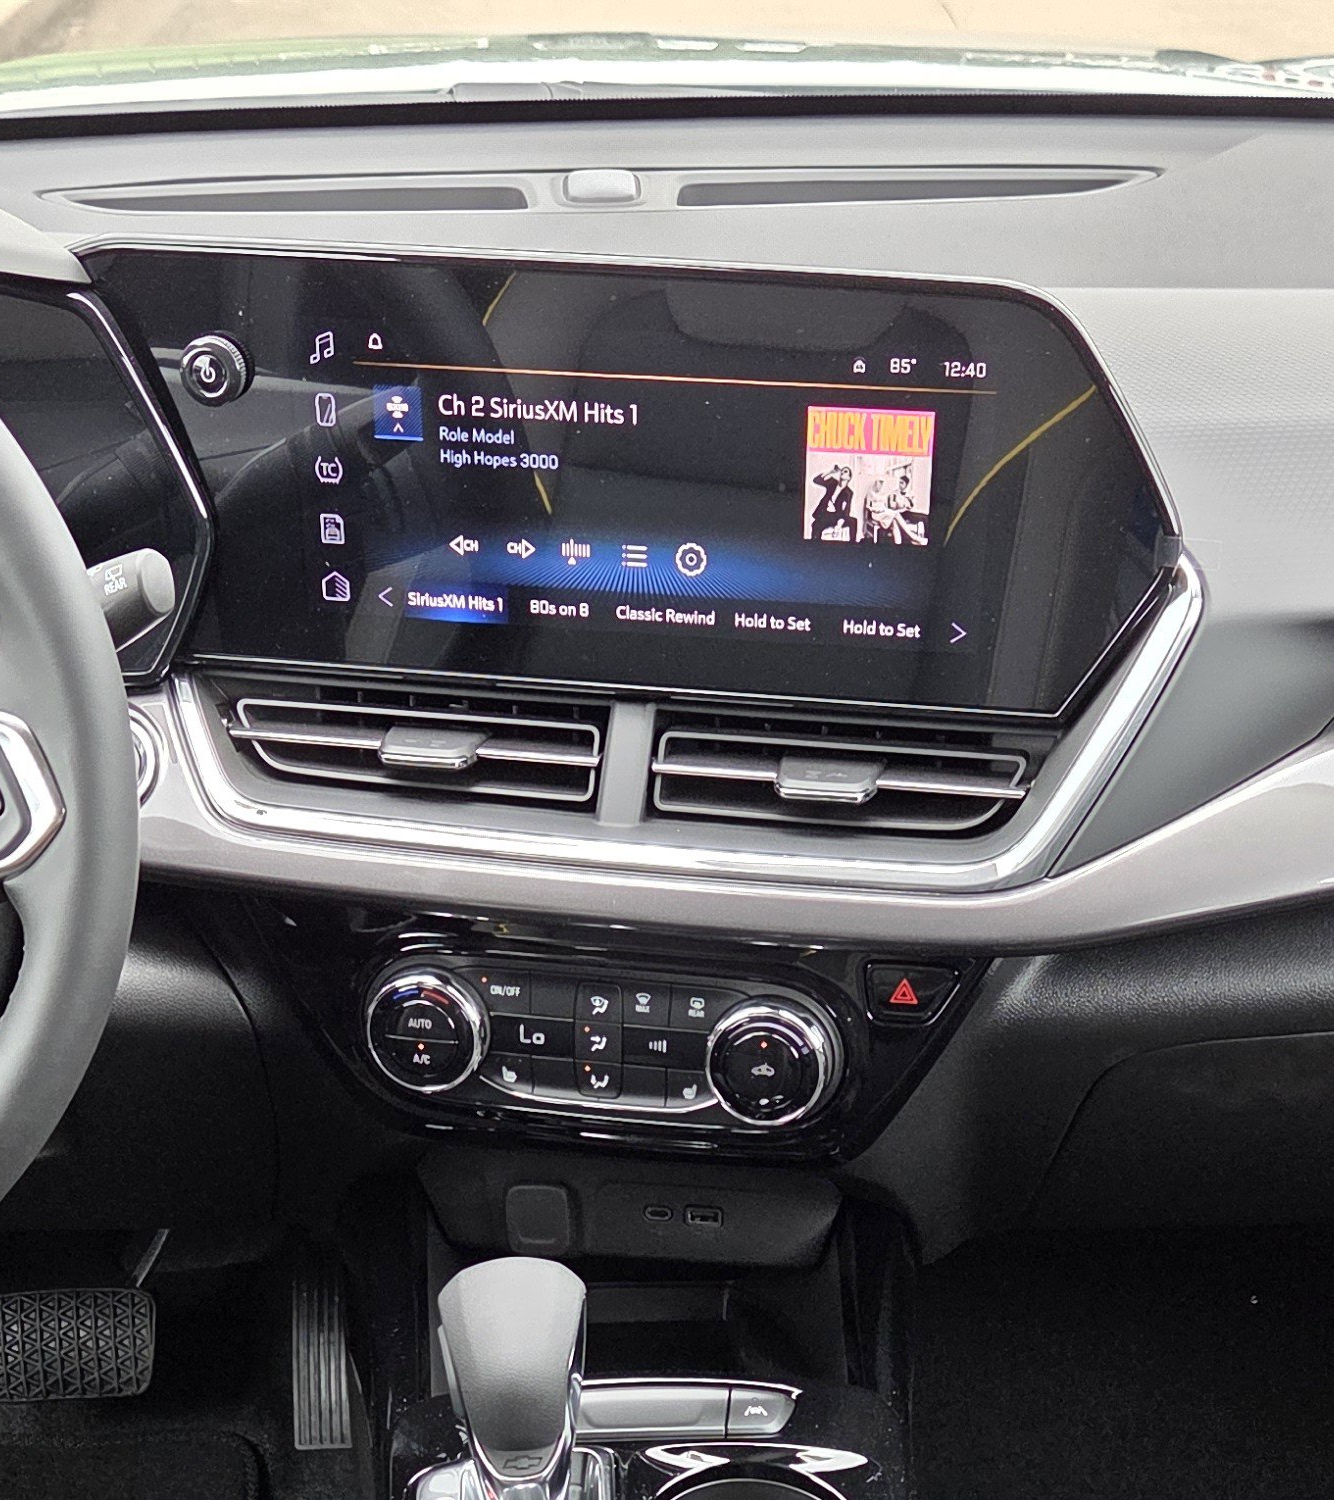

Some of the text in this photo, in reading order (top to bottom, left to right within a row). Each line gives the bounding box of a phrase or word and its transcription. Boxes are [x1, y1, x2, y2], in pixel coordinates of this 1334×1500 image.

[943, 361, 987, 378] 12:40
[437, 393, 465, 417] Ch
[471, 396, 485, 417] 2
[490, 397, 578, 423] SiriusXM
[584, 401, 625, 425] Hits
[629, 404, 638, 426] 1
[439, 426, 515, 445] Role Model
[808, 410, 933, 455] CHUCK TIMELY
[440, 449, 559, 470] High Hopes 3000
[320, 462, 337, 477] TC
[464, 539, 479, 552] CH
[104, 577, 128, 595] REAR
[407, 592, 504, 612] SiriusXM Hits 1
[529, 600, 589, 618] 80s on 8
[615, 605, 715, 626] Classic Rewind
[734, 612, 811, 632] Hold to Set
[843, 619, 921, 638] Hold to Set
[490, 985, 521, 997] ON/OFF
[408, 1017, 432, 1030] AUTO
[413, 1053, 431, 1066] A/C
